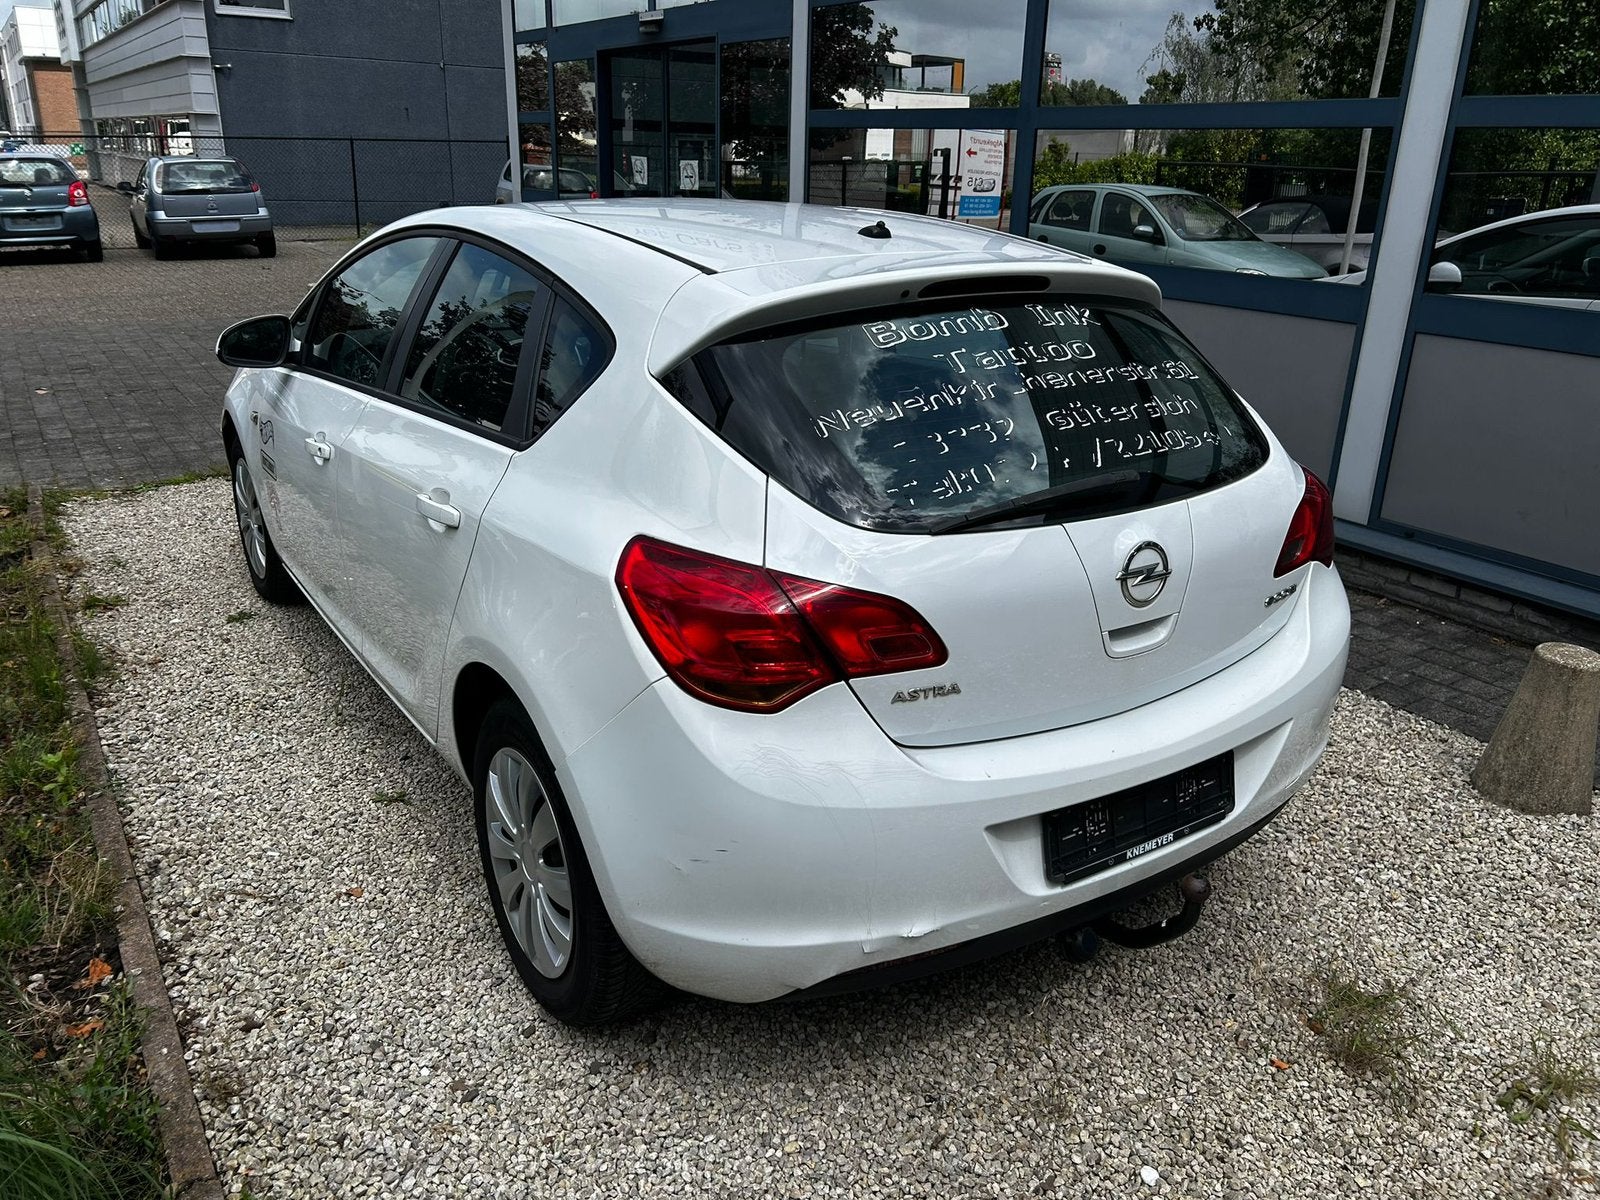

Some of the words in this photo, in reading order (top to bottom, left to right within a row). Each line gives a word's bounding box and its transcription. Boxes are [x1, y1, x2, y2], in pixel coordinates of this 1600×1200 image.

[862, 306, 1009, 349] Bomb
[1025, 303, 1101, 327] Ink
[933, 340, 1097, 374] Tattoo
[890, 682, 962, 704] ASTRA
[1126, 833, 1174, 860] KNEMEYER
